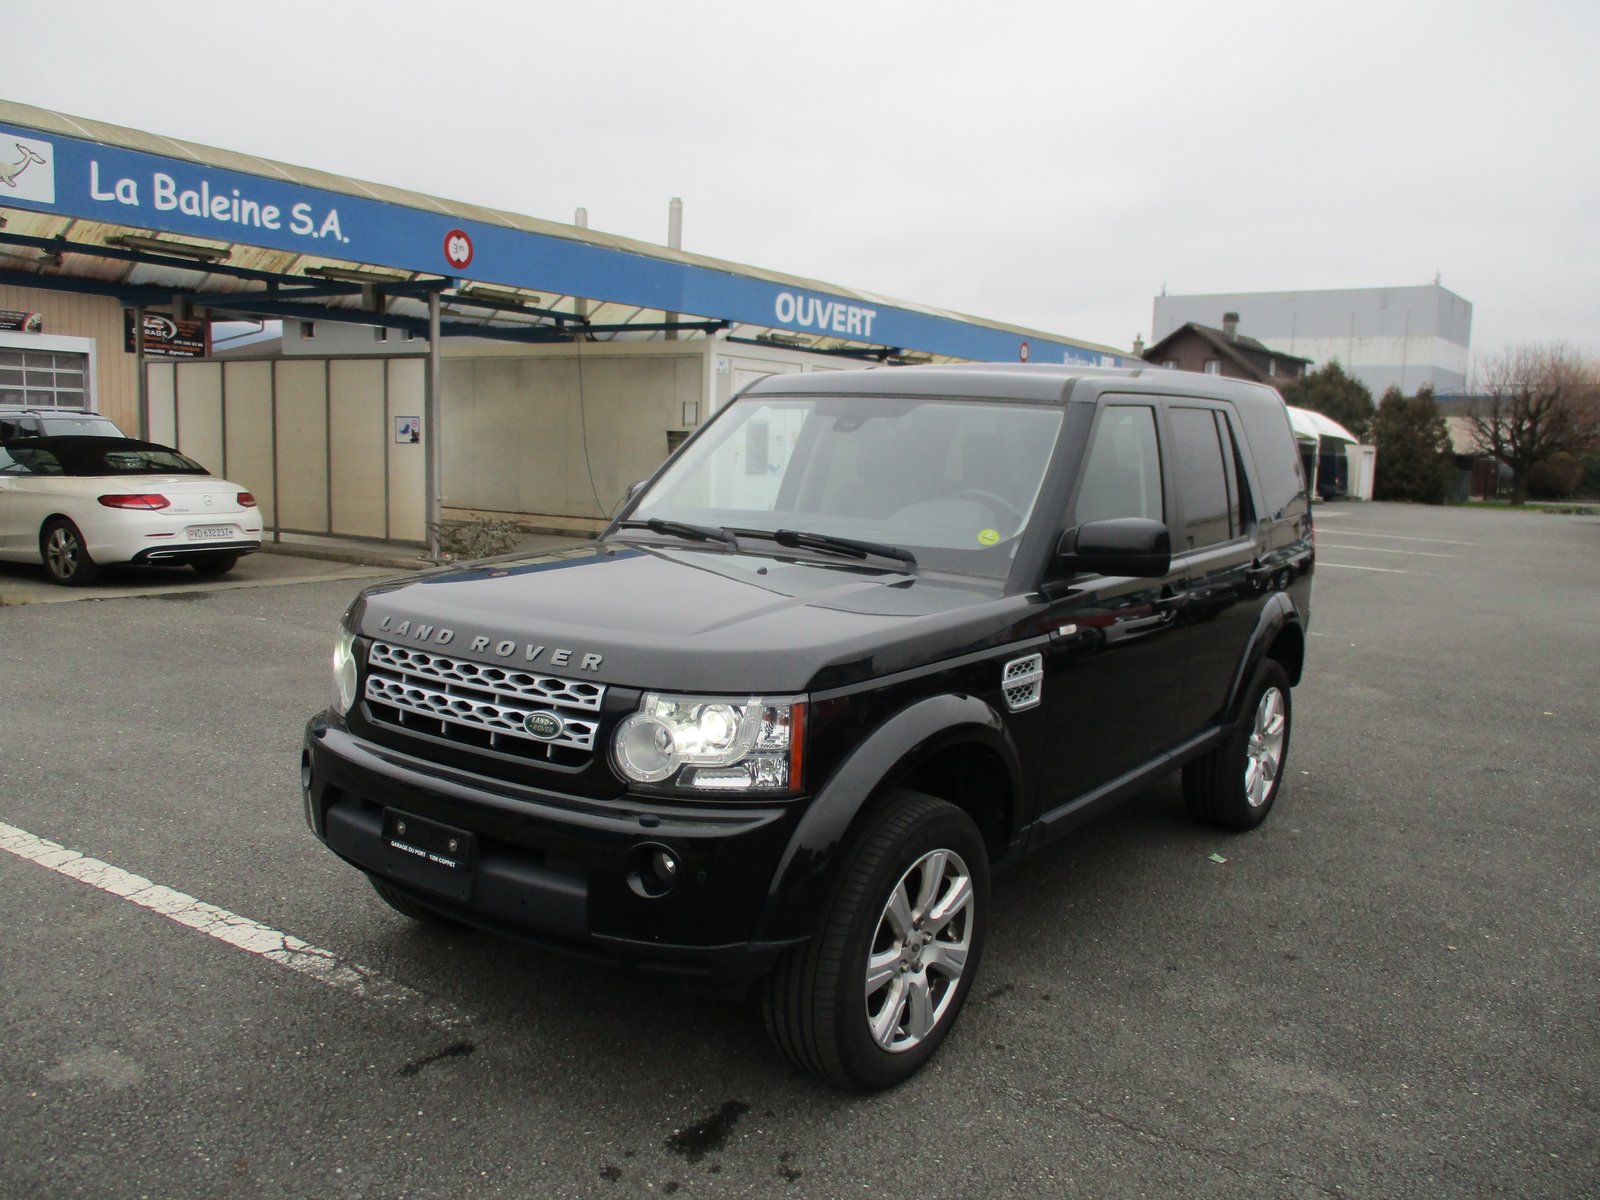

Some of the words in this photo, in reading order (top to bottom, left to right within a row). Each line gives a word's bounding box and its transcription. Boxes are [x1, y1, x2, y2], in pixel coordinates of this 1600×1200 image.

[90, 160, 139, 206] La
[153, 172, 281, 230] Baleine
[289, 202, 350, 244] S.A.
[774, 292, 877, 337] OUVERT
[132, 327, 168, 338] GRAGE
[193, 528, 203, 538] VD
[380, 616, 455, 646] LAND
[469, 634, 604, 672] ROVER
[531, 716, 550, 726] LAND
[532, 723, 554, 734] ROVER
[391, 840, 408, 851] GARAGE
[408, 846, 415, 854] DU
[415, 849, 426, 857] PORT
